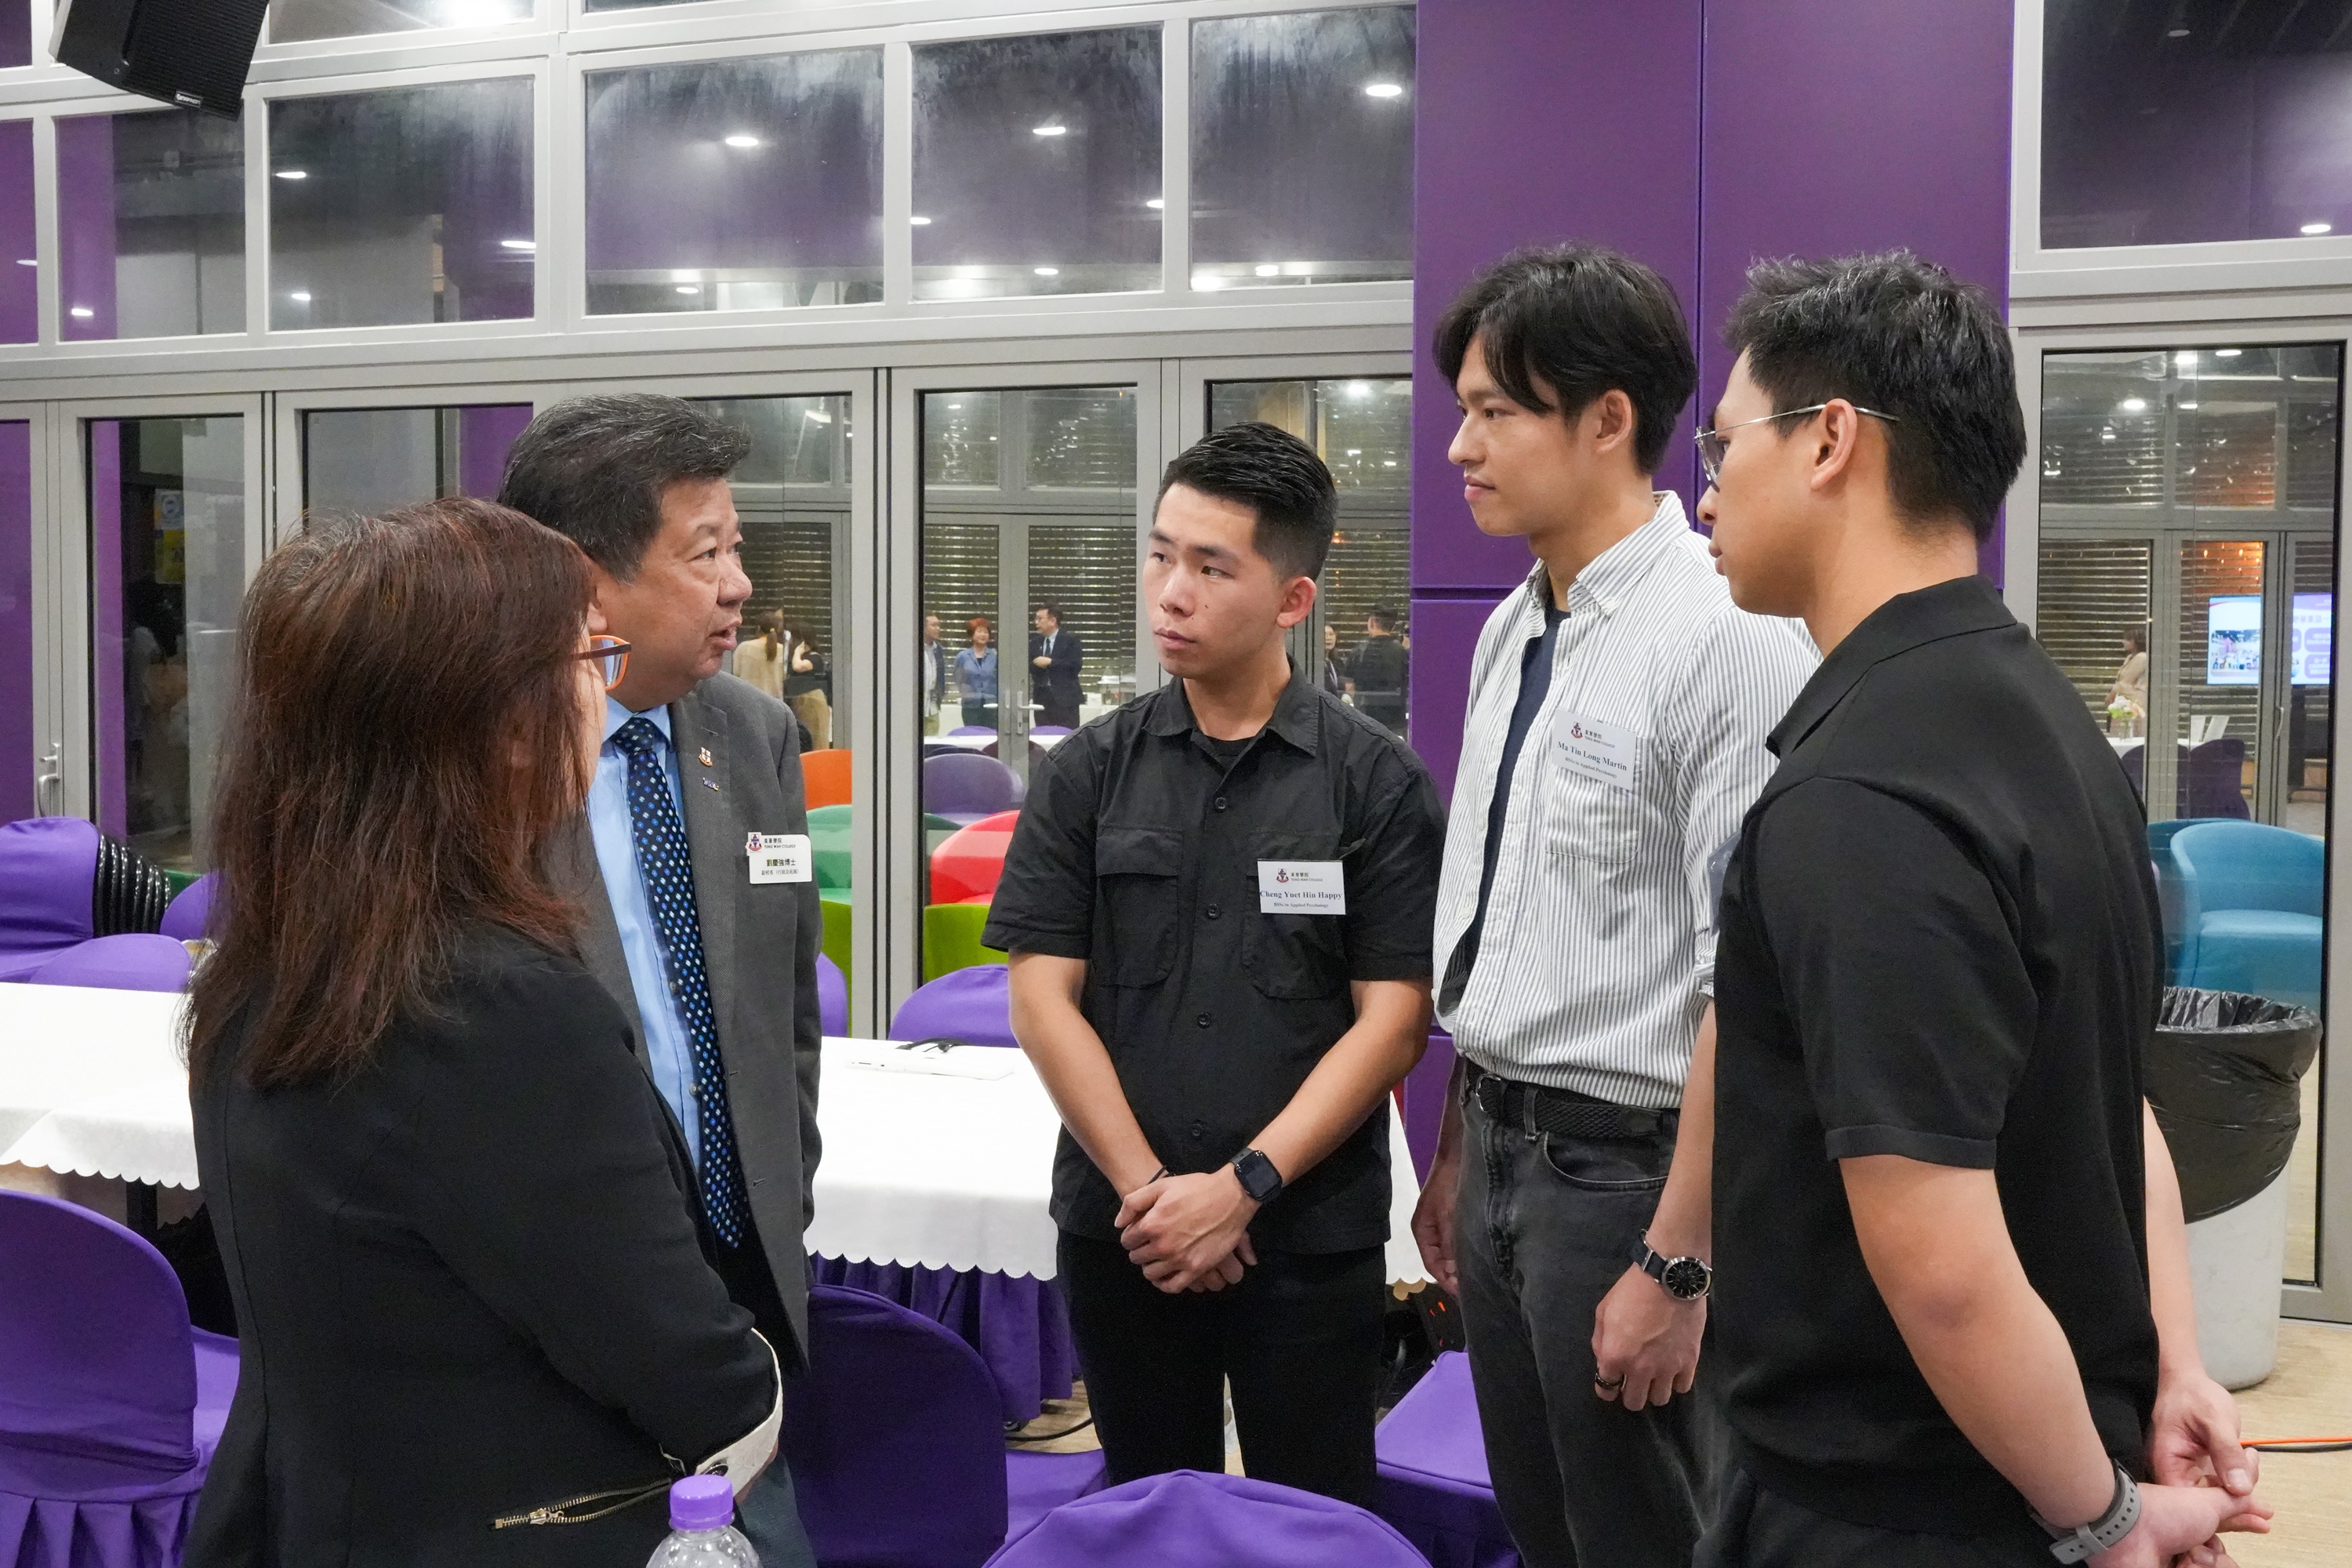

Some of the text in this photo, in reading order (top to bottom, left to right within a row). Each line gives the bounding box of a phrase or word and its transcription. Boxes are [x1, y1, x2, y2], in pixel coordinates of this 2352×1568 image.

[1557, 742, 1627, 771] Ma Tin Long Martin
